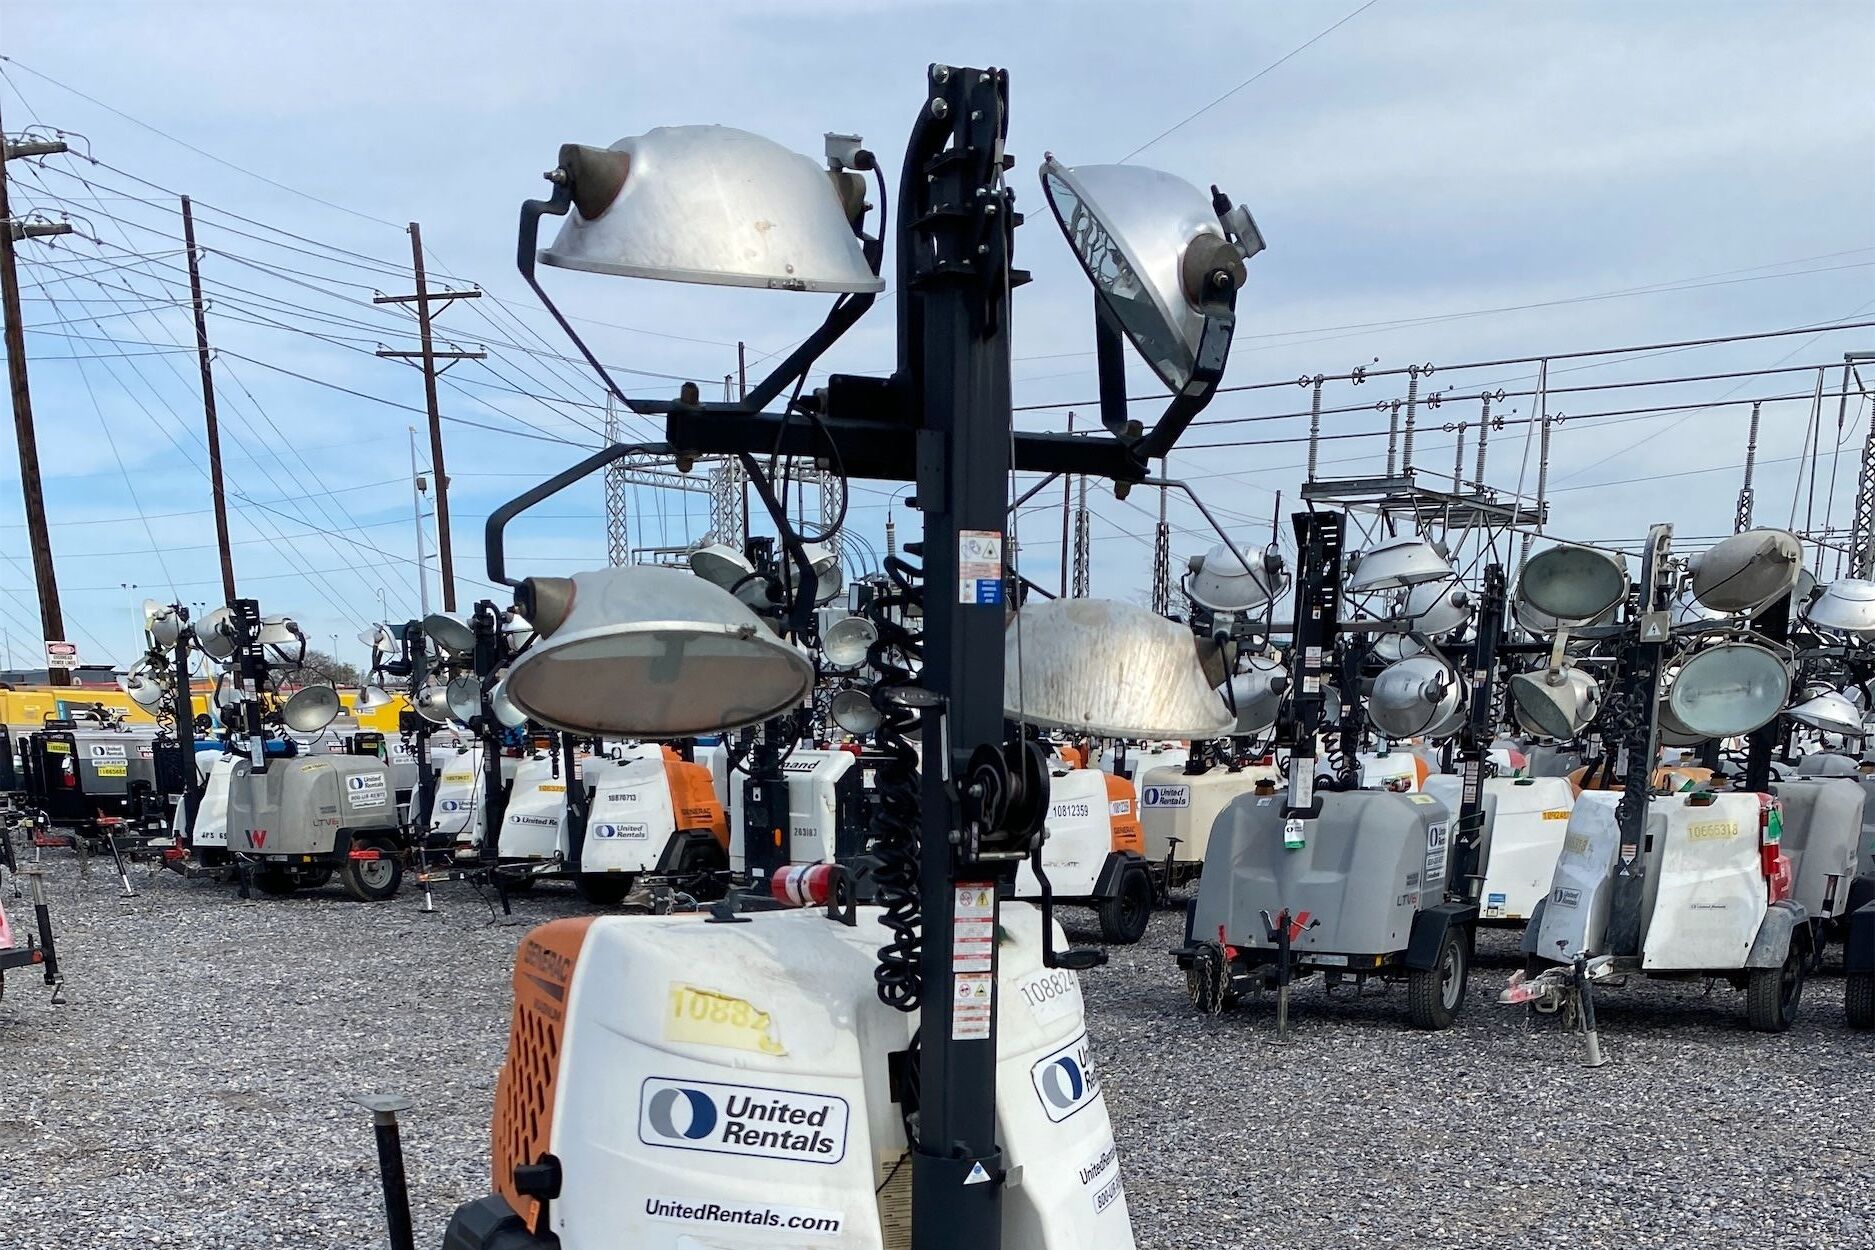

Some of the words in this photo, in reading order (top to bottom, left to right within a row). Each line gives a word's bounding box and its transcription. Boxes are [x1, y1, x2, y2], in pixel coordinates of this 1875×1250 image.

[1160, 788, 1184, 796] United
[1160, 797, 1186, 805] Rentals
[522, 817, 548, 825] United
[1053, 804, 1089, 817] 10812359
[524, 939, 571, 983] GENERAC
[725, 1094, 830, 1128] United
[721, 1121, 835, 1155] Rentals
[645, 1197, 840, 1233] UnitedRentals.com
